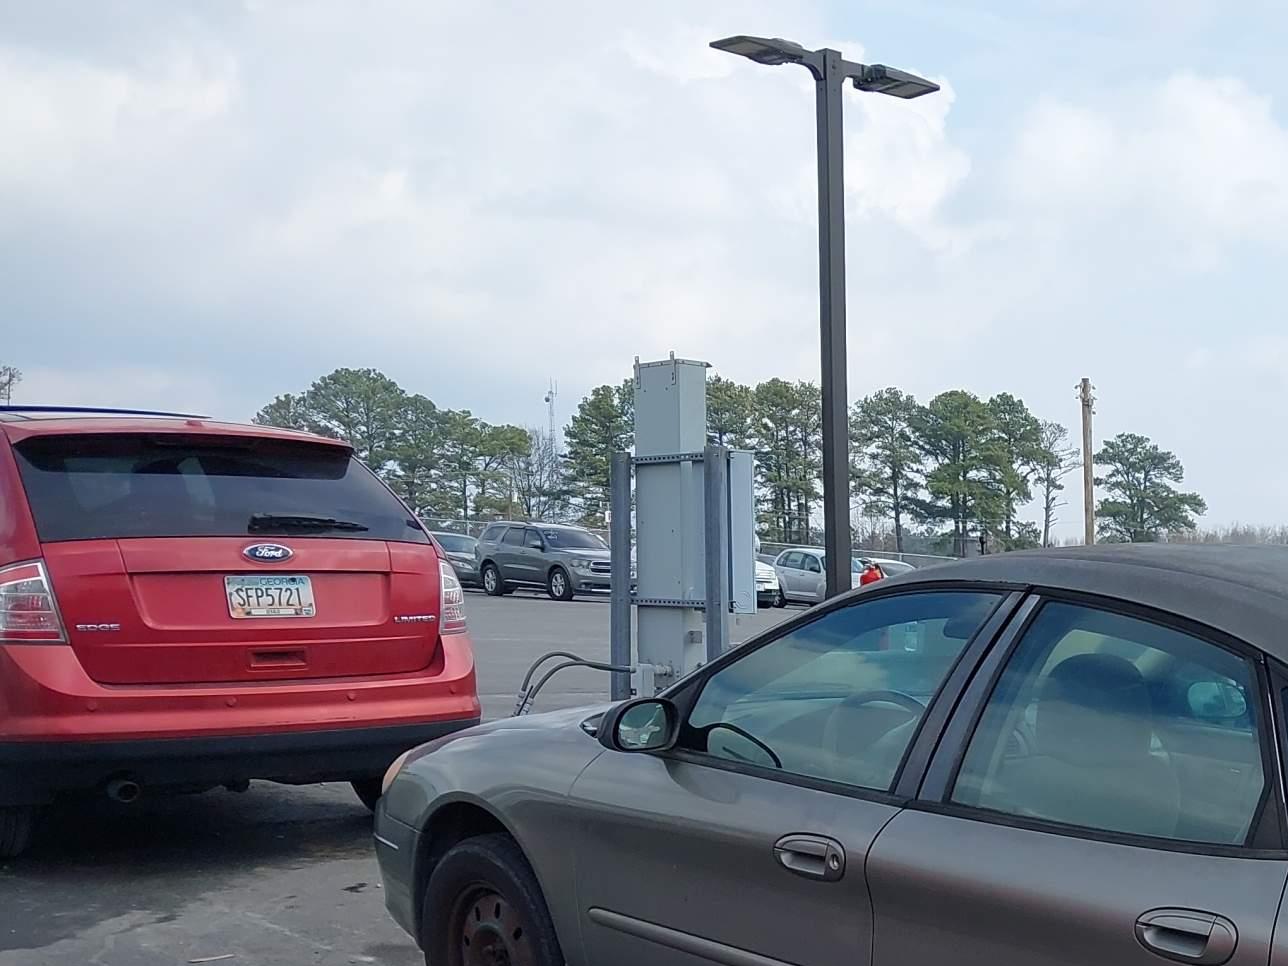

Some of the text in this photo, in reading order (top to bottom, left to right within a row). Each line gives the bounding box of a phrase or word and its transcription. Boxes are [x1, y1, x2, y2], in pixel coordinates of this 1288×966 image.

[256, 546, 283, 558] Ford
[234, 587, 302, 607] SFP5721
[76, 623, 120, 631] EDGE
